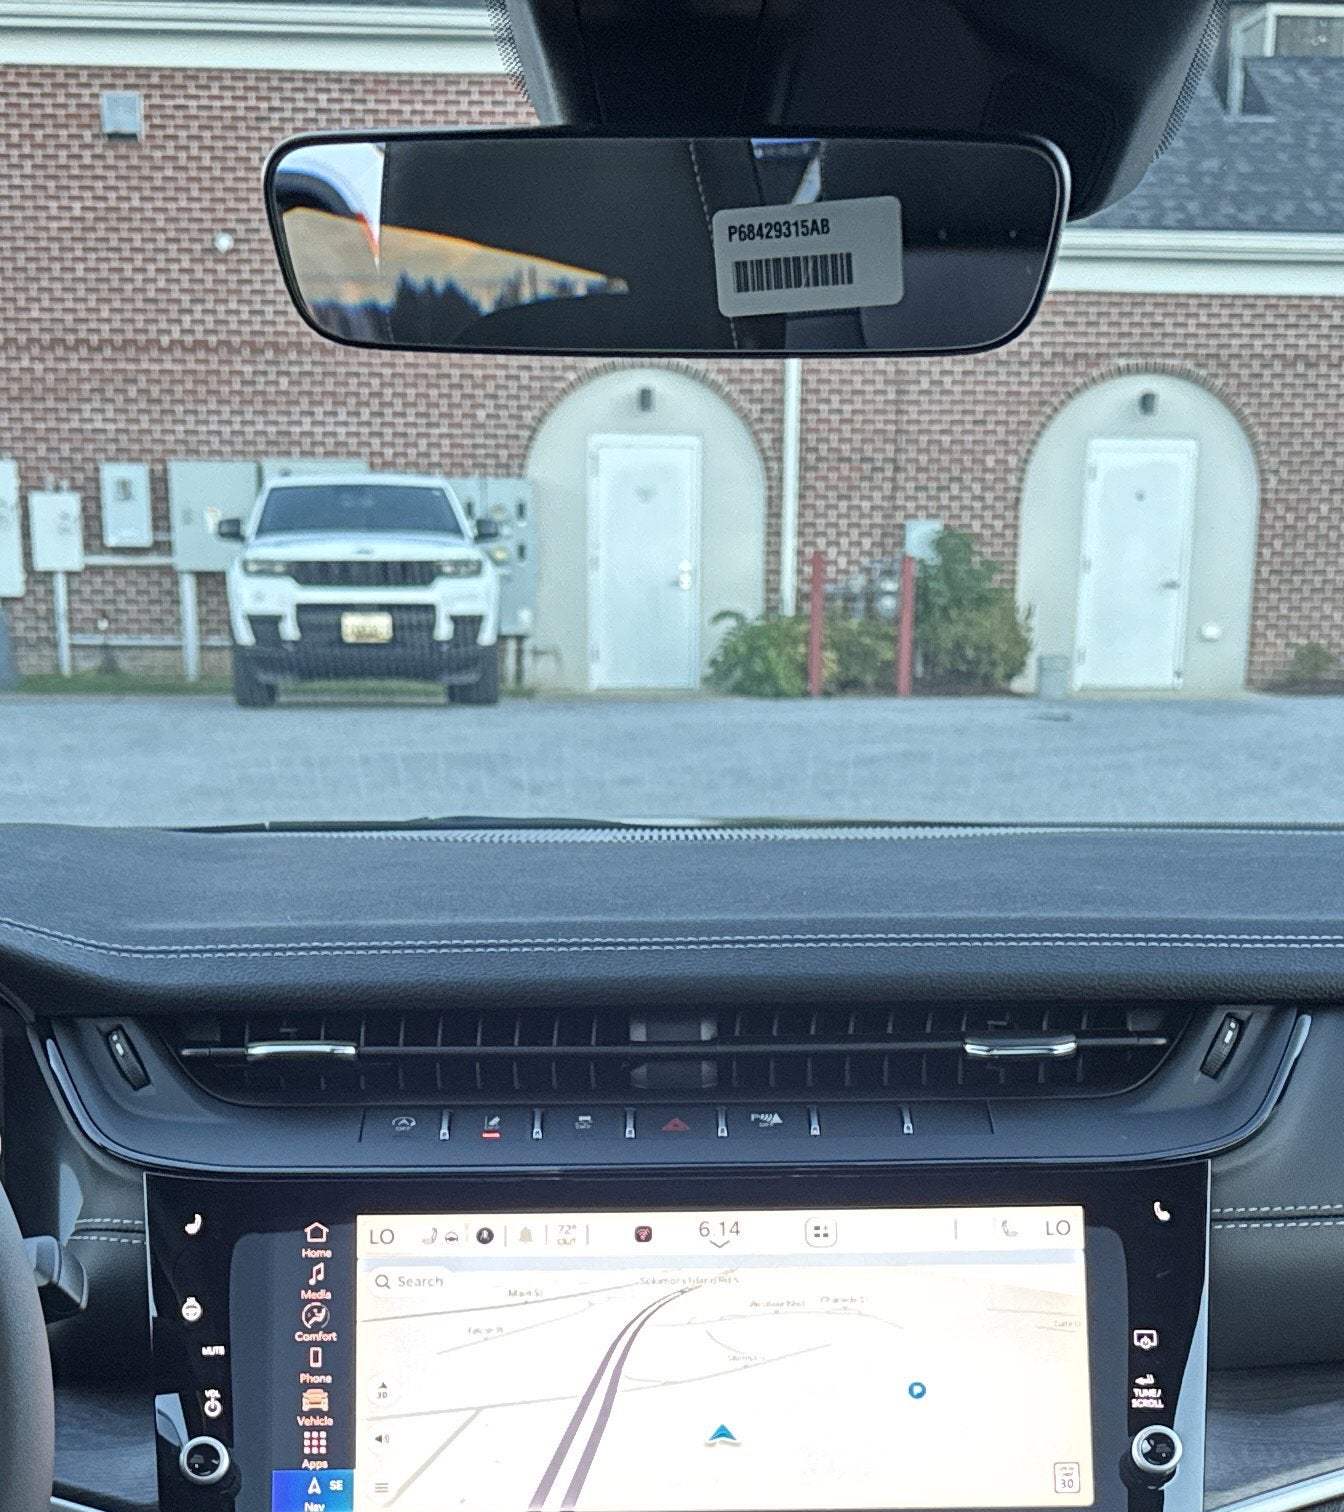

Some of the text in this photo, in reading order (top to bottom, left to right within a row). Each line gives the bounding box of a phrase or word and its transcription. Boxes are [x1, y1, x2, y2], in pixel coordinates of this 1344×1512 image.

[728, 218, 830, 243] P68429315AB
[1046, 1219, 1071, 1236] LO
[369, 1228, 395, 1245] LO
[301, 1248, 332, 1258] Home
[397, 1276, 443, 1287] Search
[301, 1289, 332, 1300] Media
[295, 1331, 338, 1342] Comfort
[299, 1373, 333, 1384] Phone
[1132, 1399, 1164, 1408] SCROLL
[297, 1416, 333, 1426] Vehicle
[301, 1458, 328, 1471] Apps
[329, 1480, 343, 1491] SE
[1061, 1478, 1074, 1489] 30
[304, 1502, 326, 1512] Nav
